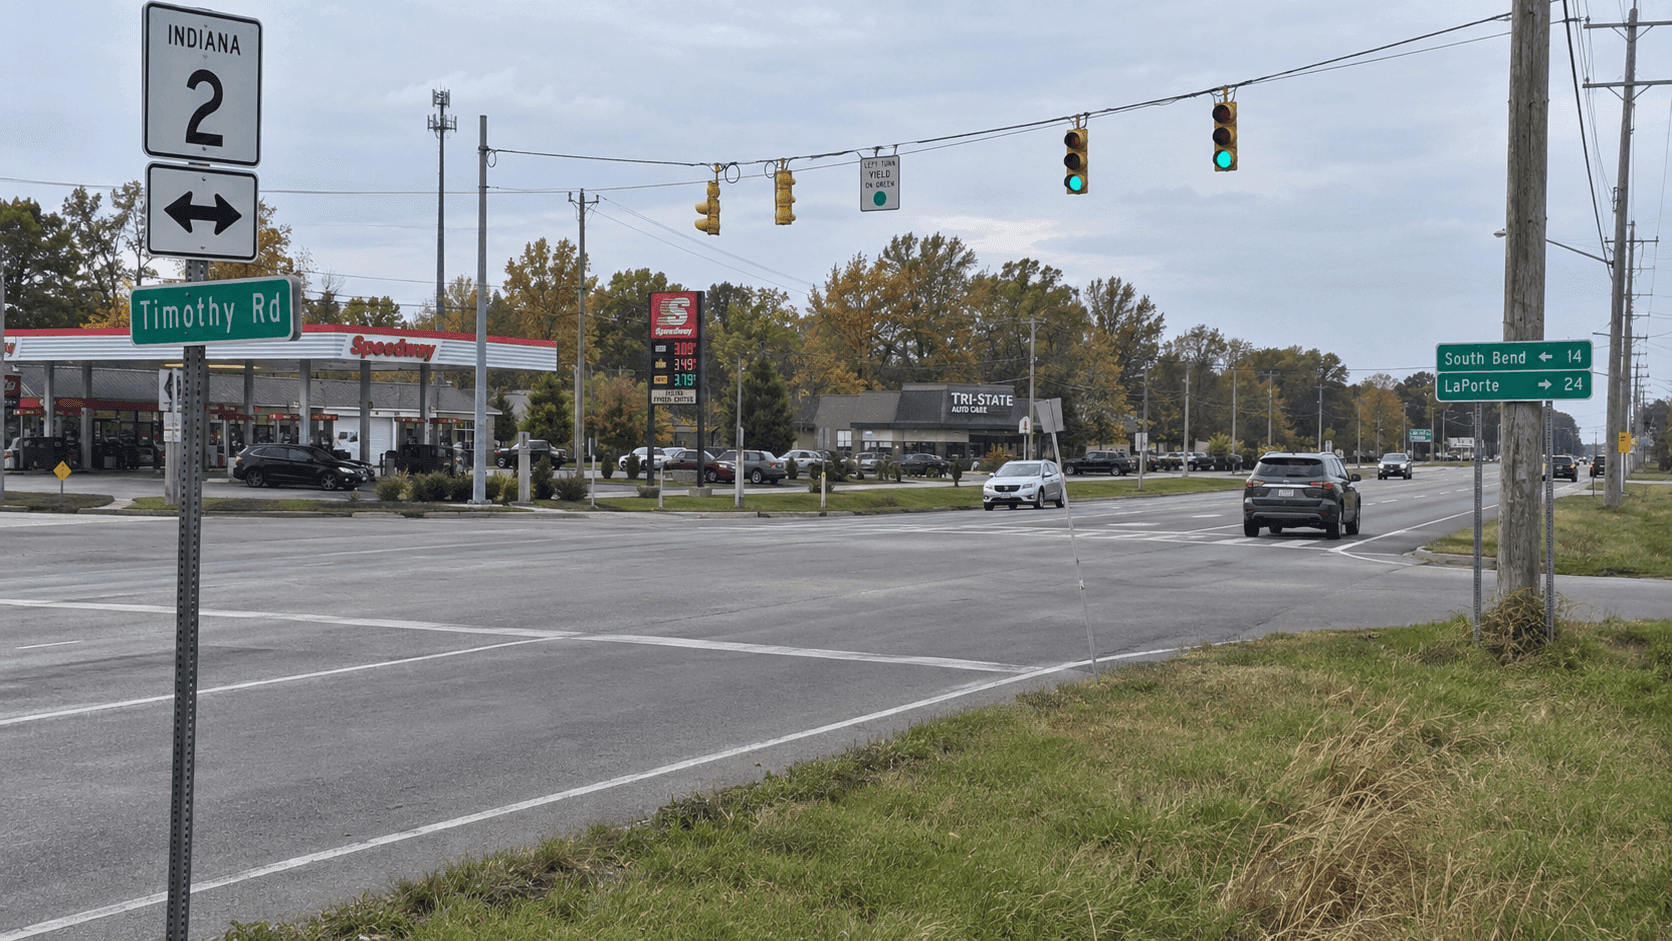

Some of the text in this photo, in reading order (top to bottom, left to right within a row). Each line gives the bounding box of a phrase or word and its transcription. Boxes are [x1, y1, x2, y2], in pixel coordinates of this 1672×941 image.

[168, 24, 241, 55] INDIANA
[185, 69, 224, 147] 2
[869, 170, 891, 178] YIELD
[140, 291, 281, 333] Timothy Rd
[655, 326, 693, 336] Speedway
[350, 335, 436, 362] Speedway
[1444, 349, 1582, 366] South Bend 14
[1444, 377, 1584, 393] LaPorte 24
[951, 392, 1014, 406] TRI-STATE
